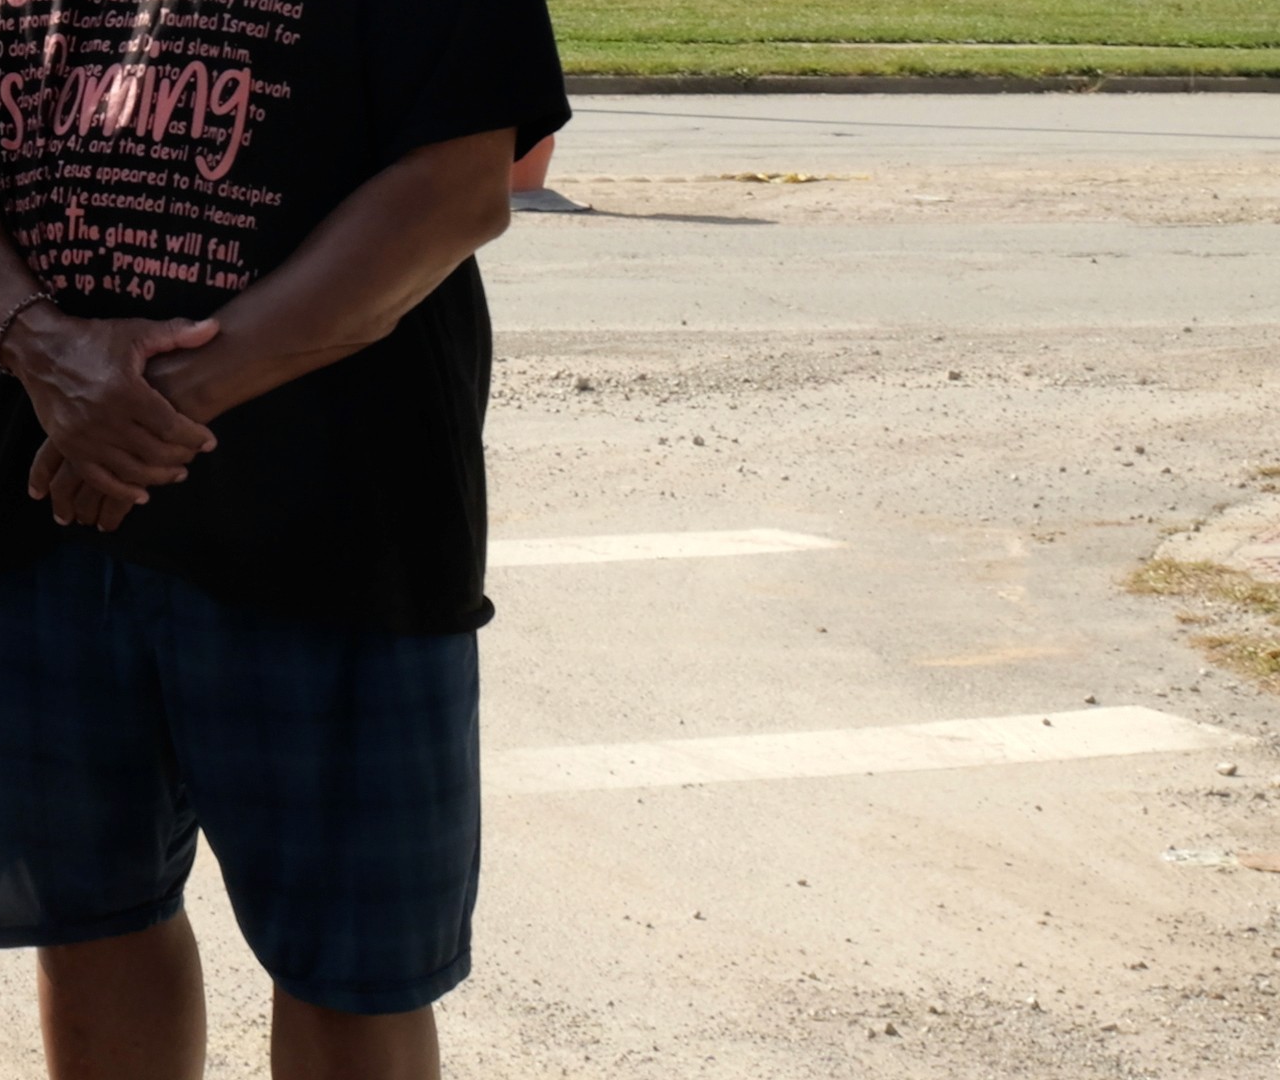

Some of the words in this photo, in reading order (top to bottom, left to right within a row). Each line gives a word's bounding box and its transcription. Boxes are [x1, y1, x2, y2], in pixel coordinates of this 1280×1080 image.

[160, 8, 218, 30] Taunted
[221, 13, 270, 38] Isreal
[275, 24, 301, 44] for
[142, 34, 184, 54] Dvid
[187, 40, 219, 58] slew
[222, 41, 252, 64] him.
[249, 104, 266, 121] to
[89, 138, 115, 154] and
[119, 138, 145, 156] the
[150, 143, 189, 162] devil
[55, 160, 92, 178] Jesus
[96, 166, 168, 186] appeared
[173, 173, 190, 189] to
[194, 175, 214, 194] his
[218, 181, 282, 207] disciples
[50, 186, 64, 203] 41
[91, 193, 166, 212] ascended
[170, 197, 199, 218] into
[61, 249, 93, 266] our
[166, 232, 202, 256] will
[75, 273, 94, 295] up
[103, 275, 121, 293] at
[127, 276, 155, 300] 40
